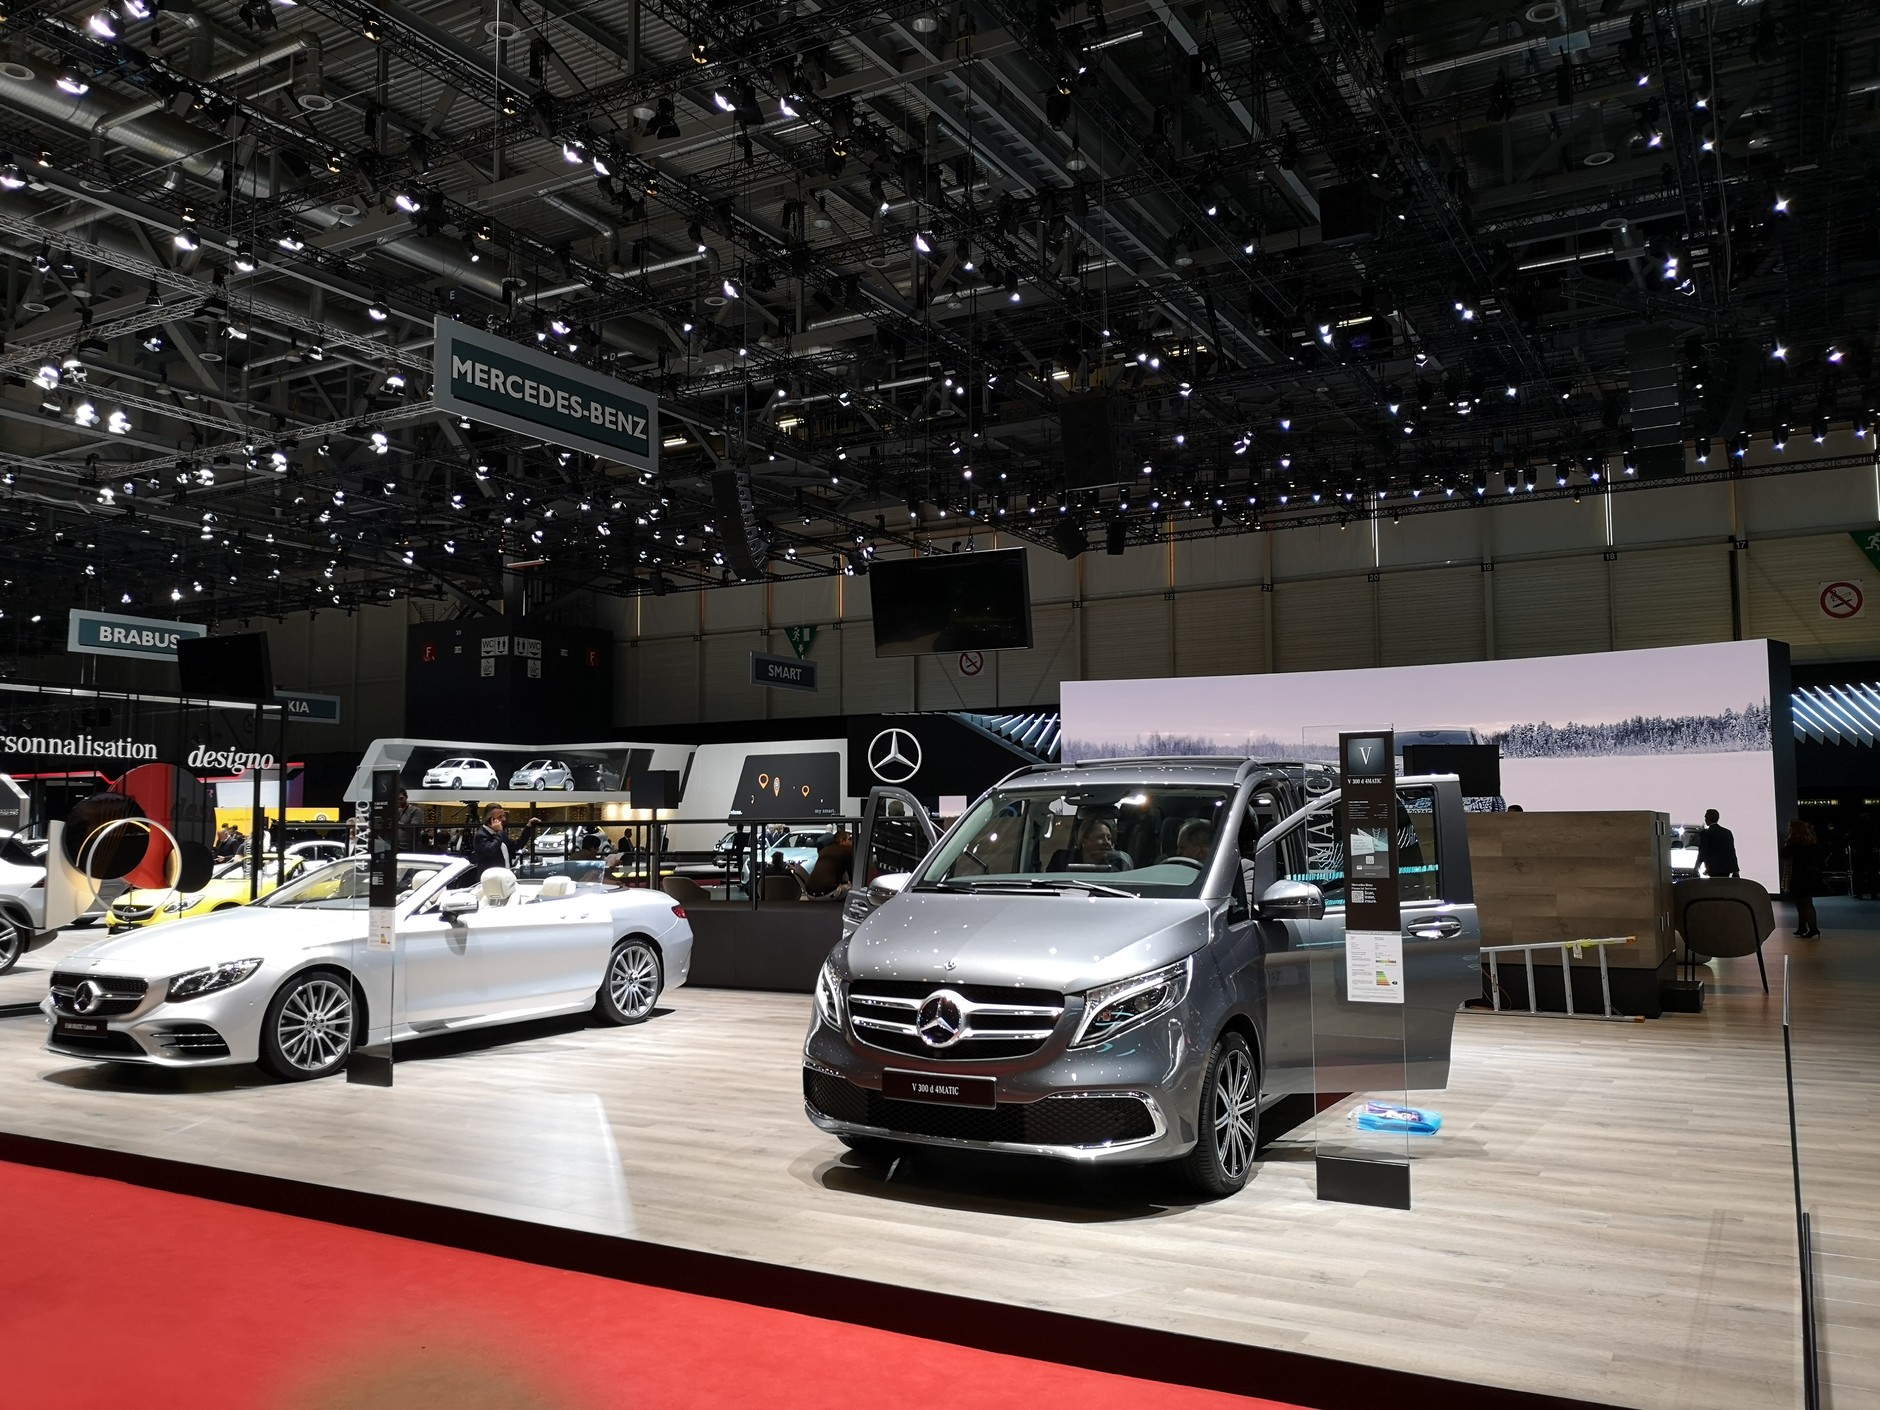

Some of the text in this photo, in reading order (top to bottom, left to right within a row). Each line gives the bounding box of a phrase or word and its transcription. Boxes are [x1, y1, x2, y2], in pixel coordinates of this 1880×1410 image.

[452, 355, 647, 440] MERCEDES-BENZ
[1736, 541, 1747, 549] 17
[1605, 552, 1616, 560] 18
[1482, 563, 1492, 571] 19
[99, 625, 180, 649] BRABUS
[483, 640, 495, 648] WC
[529, 642, 541, 650] WC
[768, 664, 802, 681] SMART
[288, 700, 310, 713] KIA
[188, 744, 274, 775] designo
[1359, 746, 1372, 765] V
[912, 1083, 959, 1095] V 300 d 4MATIC
